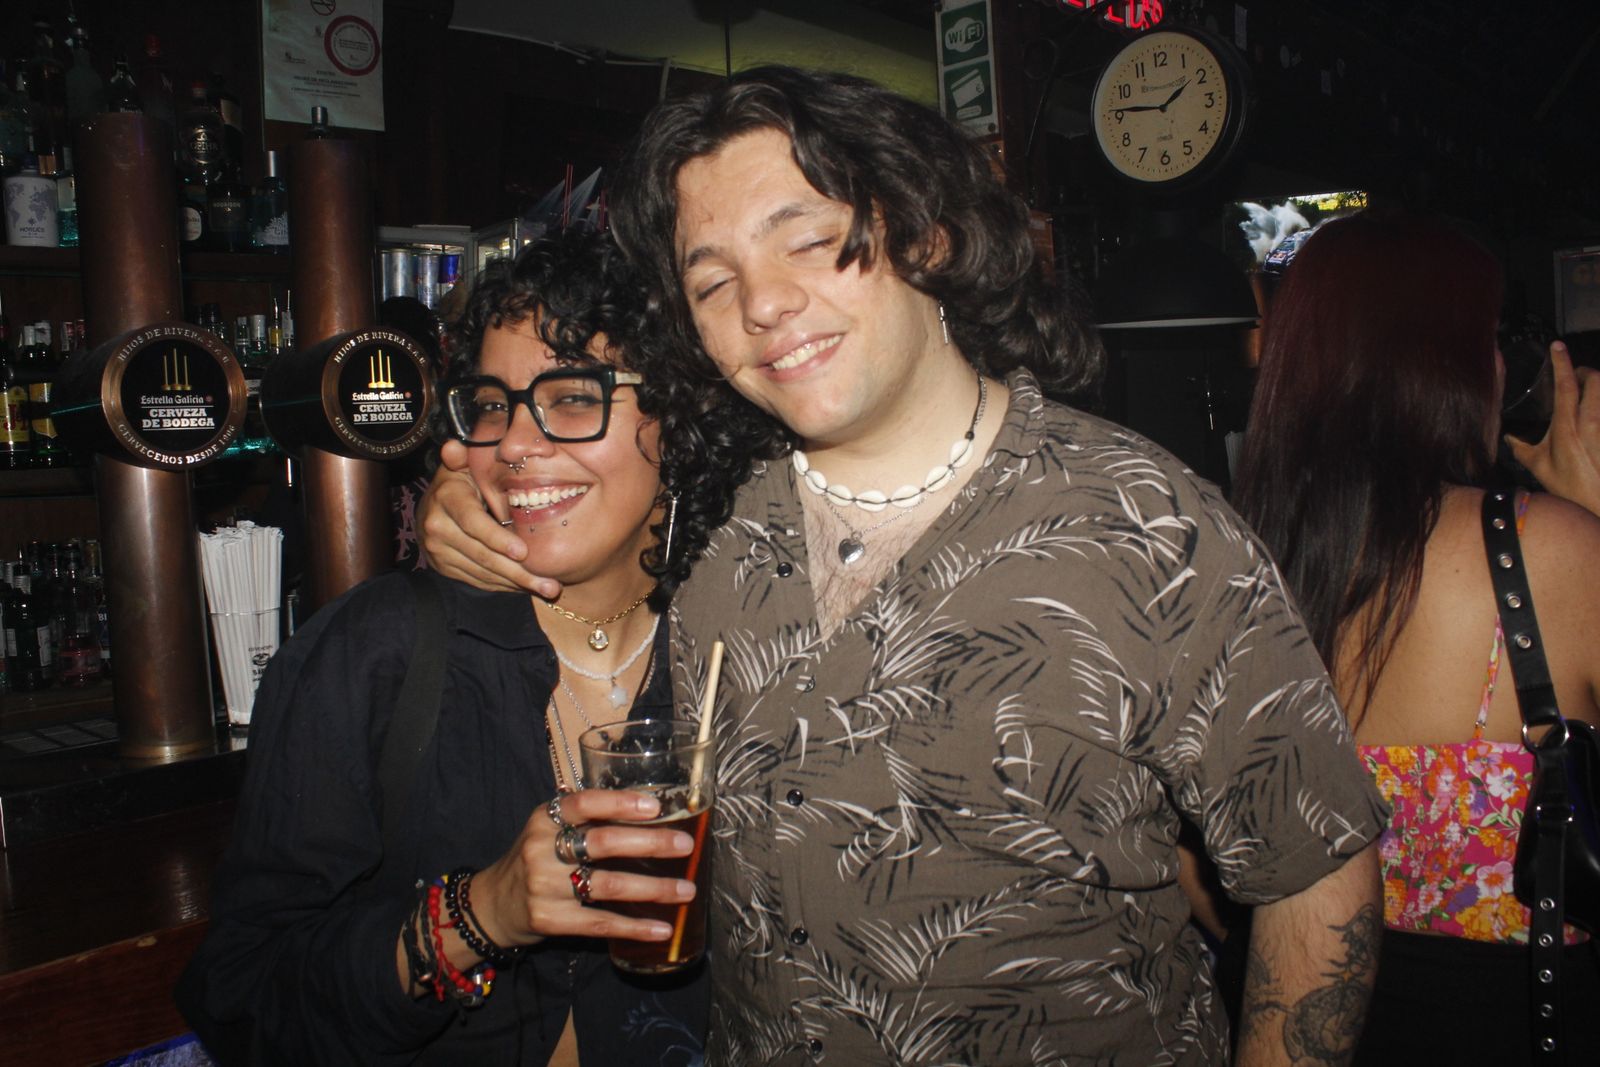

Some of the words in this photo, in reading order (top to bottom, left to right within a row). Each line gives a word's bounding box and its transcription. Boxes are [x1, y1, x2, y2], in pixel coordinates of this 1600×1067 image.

[1153, 51, 1168, 67] 12
[1180, 53, 1186, 69] 1
[1134, 62, 1145, 78] 11
[1195, 68, 1207, 84] 2
[1118, 84, 1131, 99] 10
[1204, 92, 1215, 108] 3
[1114, 109, 1125, 124] 9
[1198, 119, 1209, 134] 4
[1121, 132, 1131, 147] 8
[1138, 147, 1147, 163] 7
[1182, 140, 1193, 156] 5
[1160, 150, 1171, 165] 6
[144, 328, 162, 340] DE
[333, 339, 356, 363] HIJOS
[356, 332, 370, 344] DE
[371, 331, 406, 346] RIVERA
[140, 394, 174, 405] Estrella
[174, 394, 204, 404] Galicia
[351, 392, 379, 401] Estrella
[379, 391, 404, 401] Galicia
[148, 407, 207, 418] CERVEZA
[359, 403, 407, 413] CERVEZA
[142, 418, 161, 428] DE
[162, 417, 215, 428] BODEGA
[353, 413, 369, 423] DE
[369, 411, 413, 422] BODEGA
[118, 424, 183, 465] CERVECEROS
[185, 443, 220, 464] DESDE
